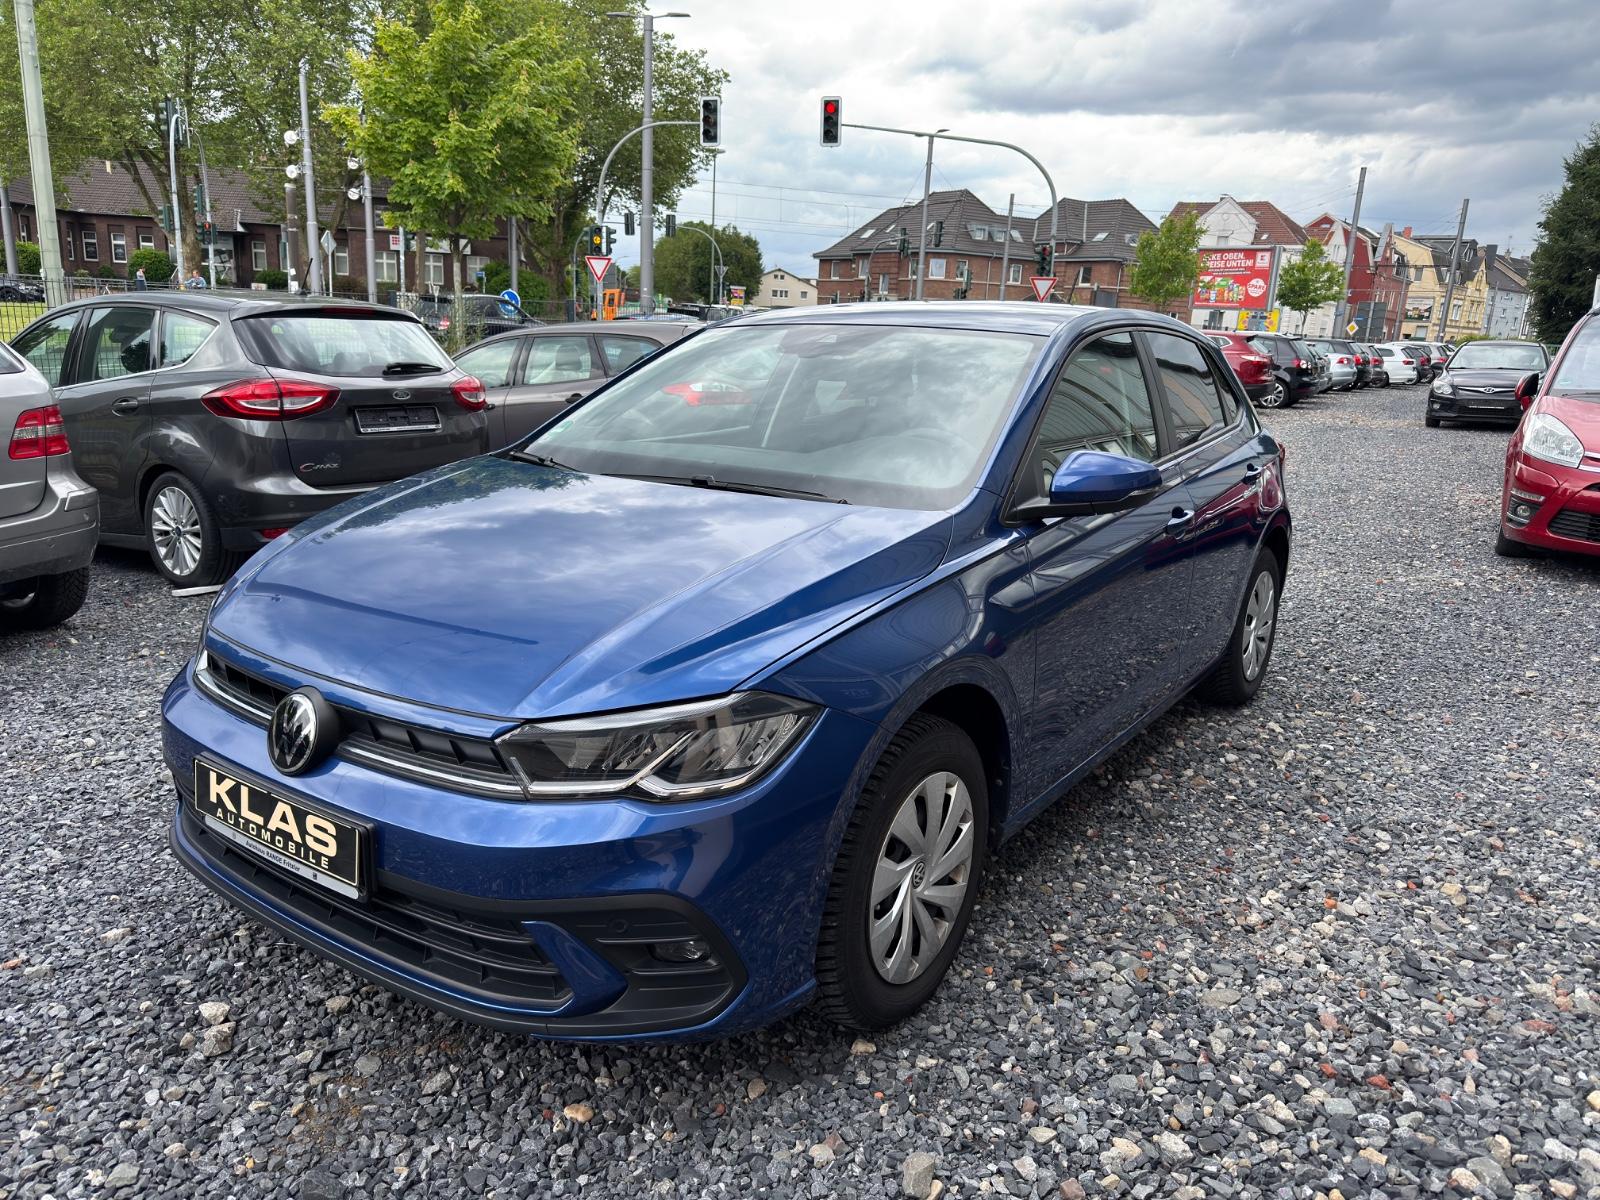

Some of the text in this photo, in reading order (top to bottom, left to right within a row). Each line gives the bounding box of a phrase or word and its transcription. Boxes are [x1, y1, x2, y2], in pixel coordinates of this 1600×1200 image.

[1226, 259, 1254, 267] UNTEN!
[209, 769, 338, 857] KLAS
[216, 807, 330, 869] AUTOMOBILE
